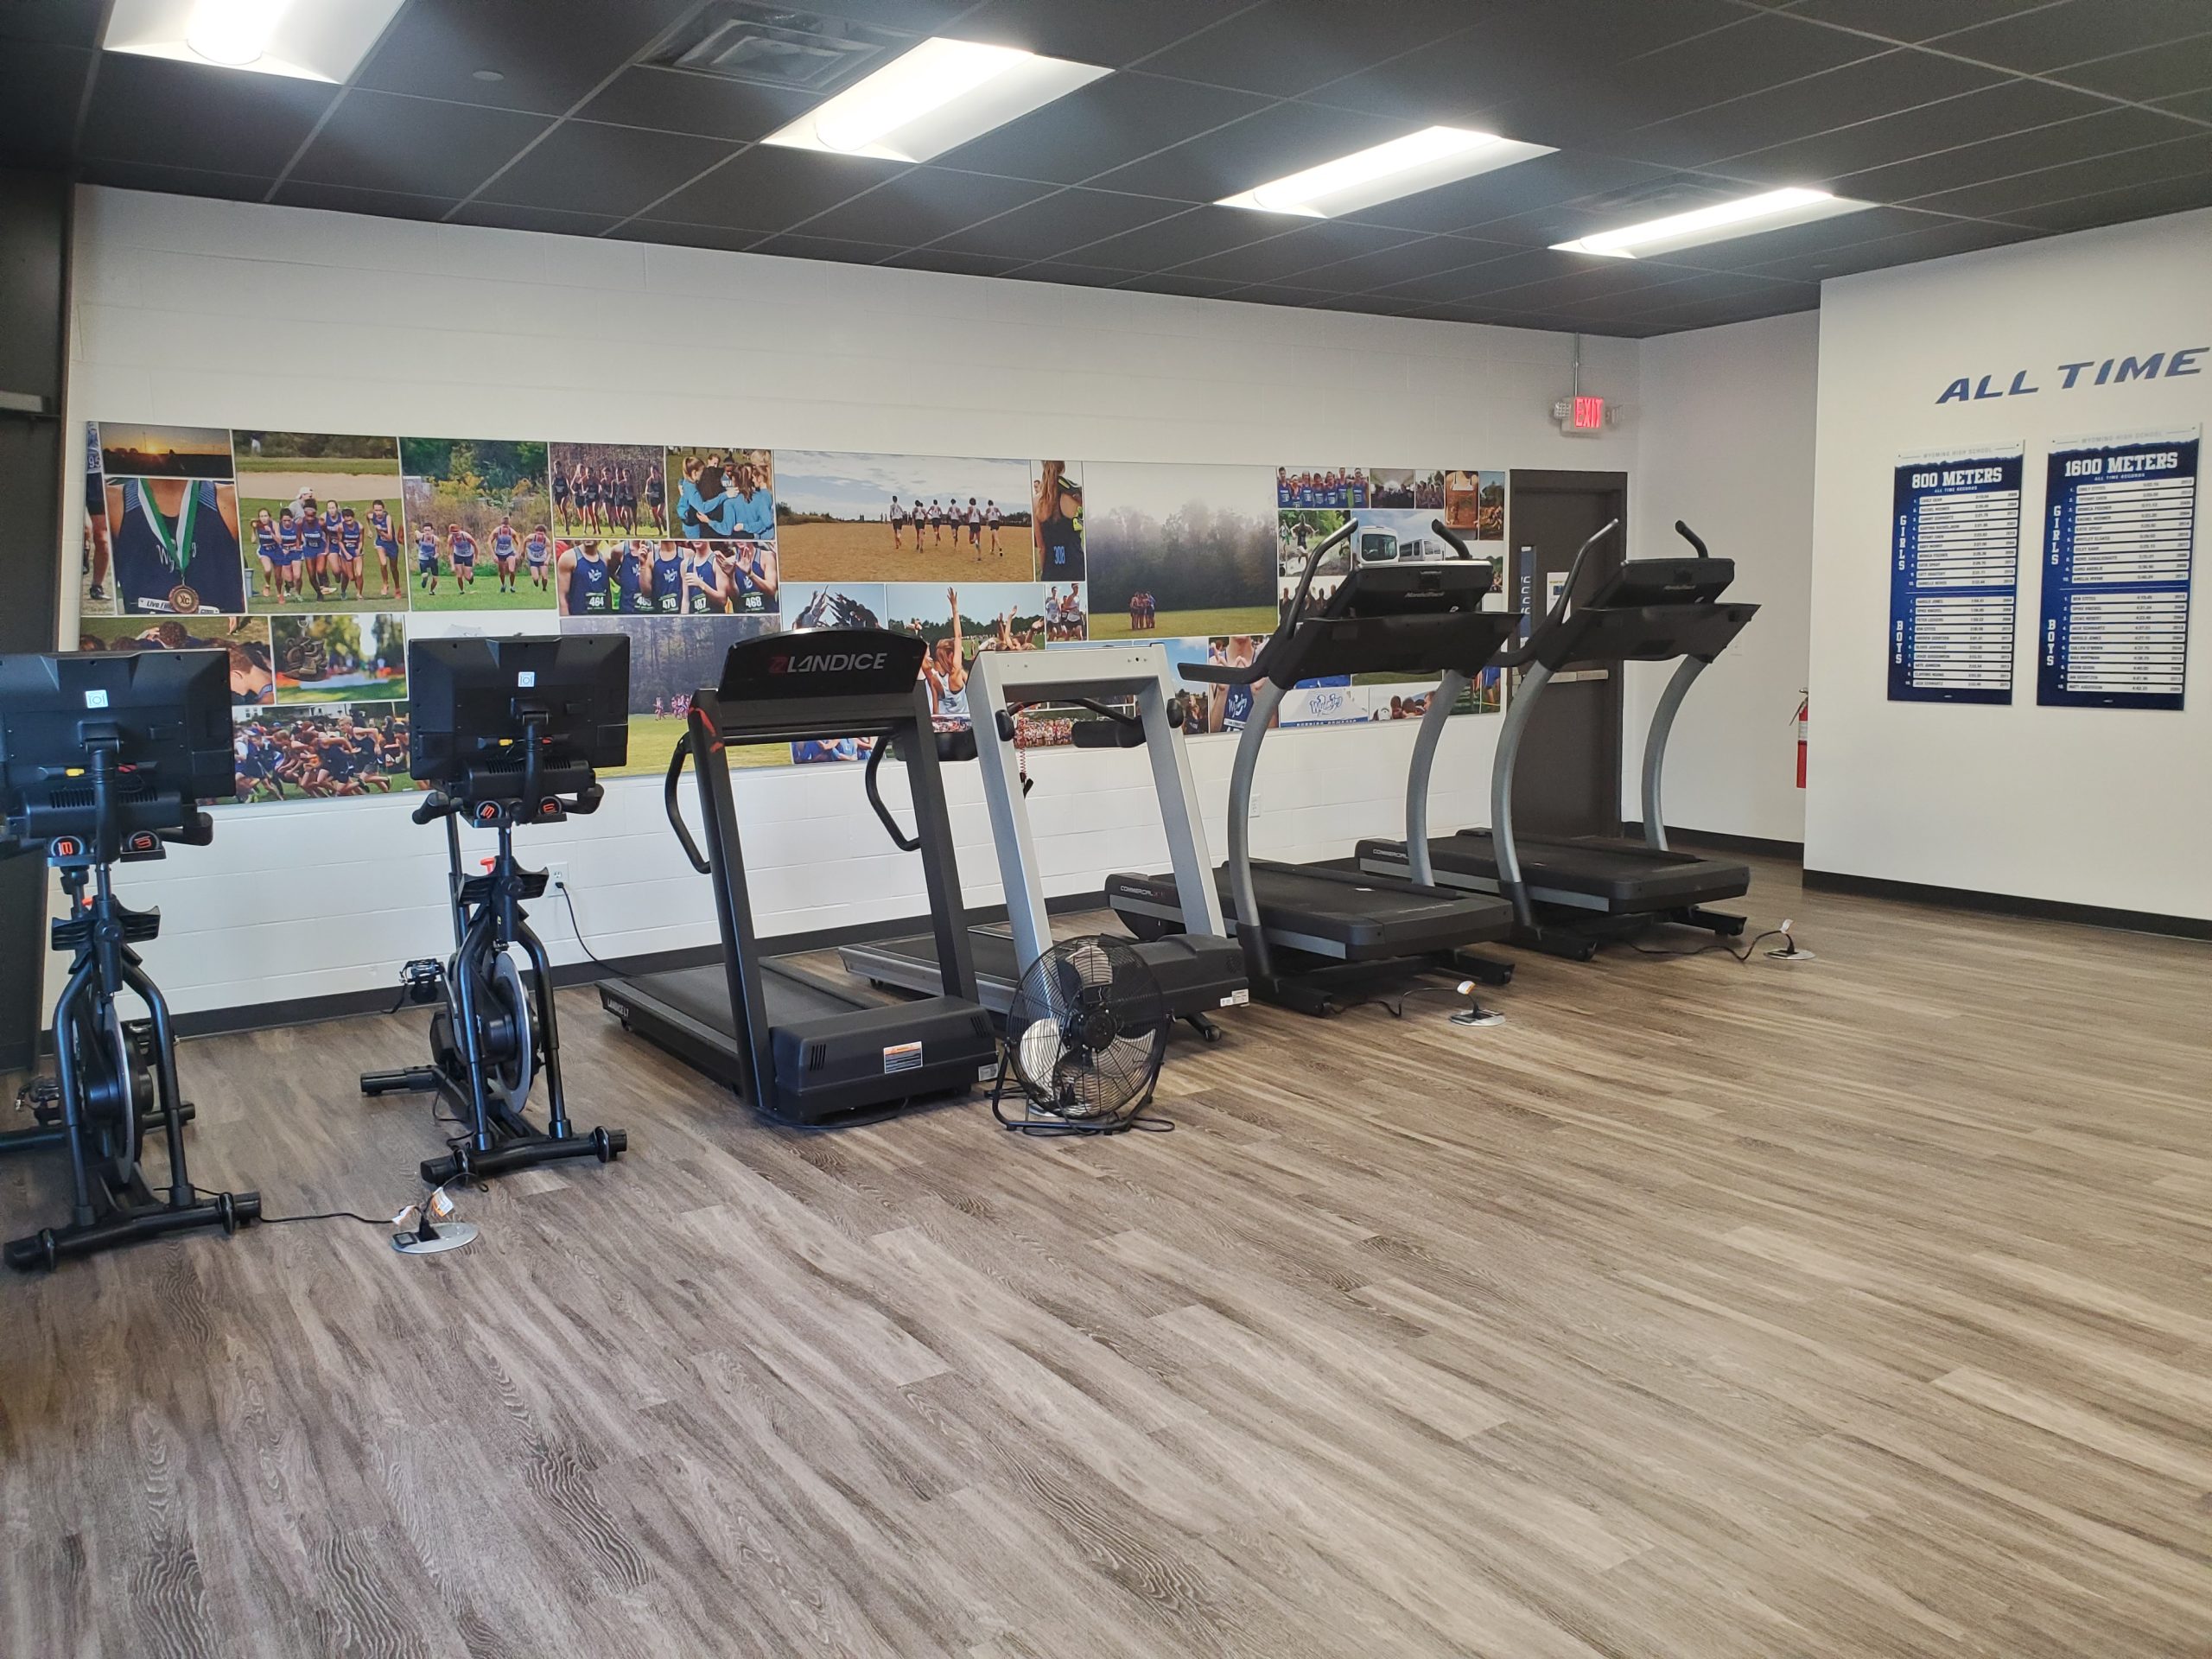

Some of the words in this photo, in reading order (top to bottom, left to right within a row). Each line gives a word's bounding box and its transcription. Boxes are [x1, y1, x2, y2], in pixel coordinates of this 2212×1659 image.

[1935, 370, 2039, 404] ALL
[2057, 346, 2211, 389] TIME
[1575, 397, 1604, 428] EXIT
[2064, 458, 2102, 477] 1600
[2107, 452, 2178, 474] METERS
[1911, 472, 1938, 489] 800
[1942, 467, 2003, 486] METERS
[1898, 515, 1907, 570] GIRLS
[2050, 505, 2062, 565] GIRLS
[1053, 546, 1065, 564] 308
[588, 596, 604, 607] 464
[662, 596, 677, 608] 470
[745, 596, 762, 607] 468
[2046, 619, 2056, 665] BOYS
[786, 652, 888, 673] LANDICE
[1120, 885, 1154, 896] COMMERCIAL
